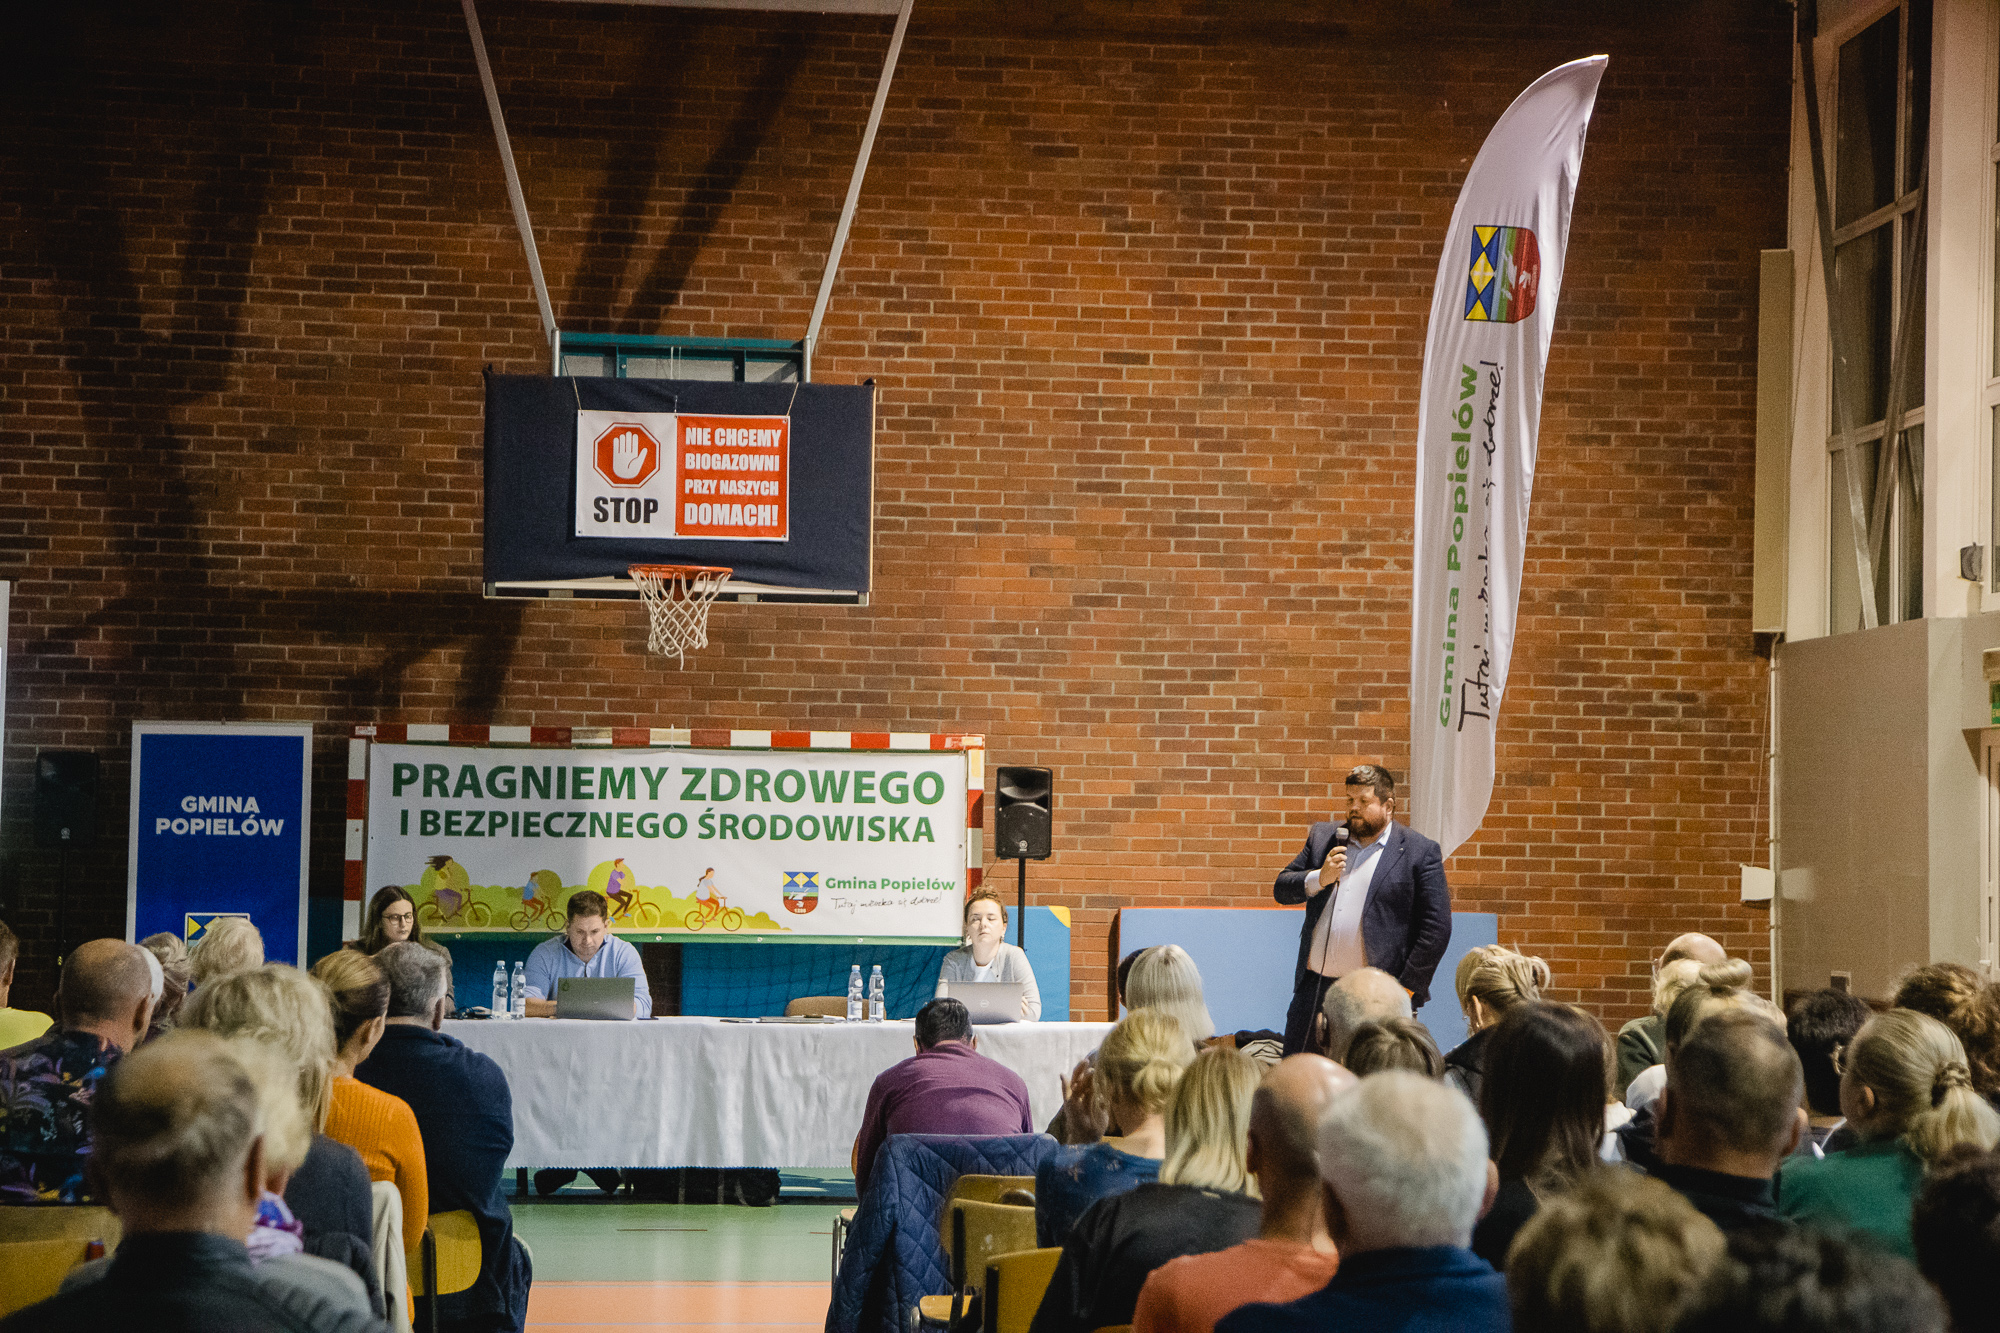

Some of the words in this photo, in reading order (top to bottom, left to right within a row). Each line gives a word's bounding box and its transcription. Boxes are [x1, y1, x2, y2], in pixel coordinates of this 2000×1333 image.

[685, 427, 712, 446] NIE
[714, 428, 782, 447] CHCEMY
[685, 453, 780, 472] BIOGAZOWNI
[1447, 363, 1478, 571] Popielów
[684, 479, 717, 494] PRZY
[719, 480, 779, 496] NASZYCH
[593, 496, 659, 524] STOP
[684, 502, 779, 526] DOMACH!
[1440, 587, 1459, 727] Gmina
[392, 763, 669, 800] PRAGNIEMY
[680, 767, 945, 805] ZDROWEGO
[181, 796, 260, 814] GMINA
[155, 814, 284, 836] POPIELÓW
[400, 809, 409, 836] I
[419, 809, 688, 839] BEZPIECZNEGO
[698, 807, 935, 843] ŚRODOWISKA
[825, 877, 877, 890] Gmina
[881, 877, 956, 892] Popielów
